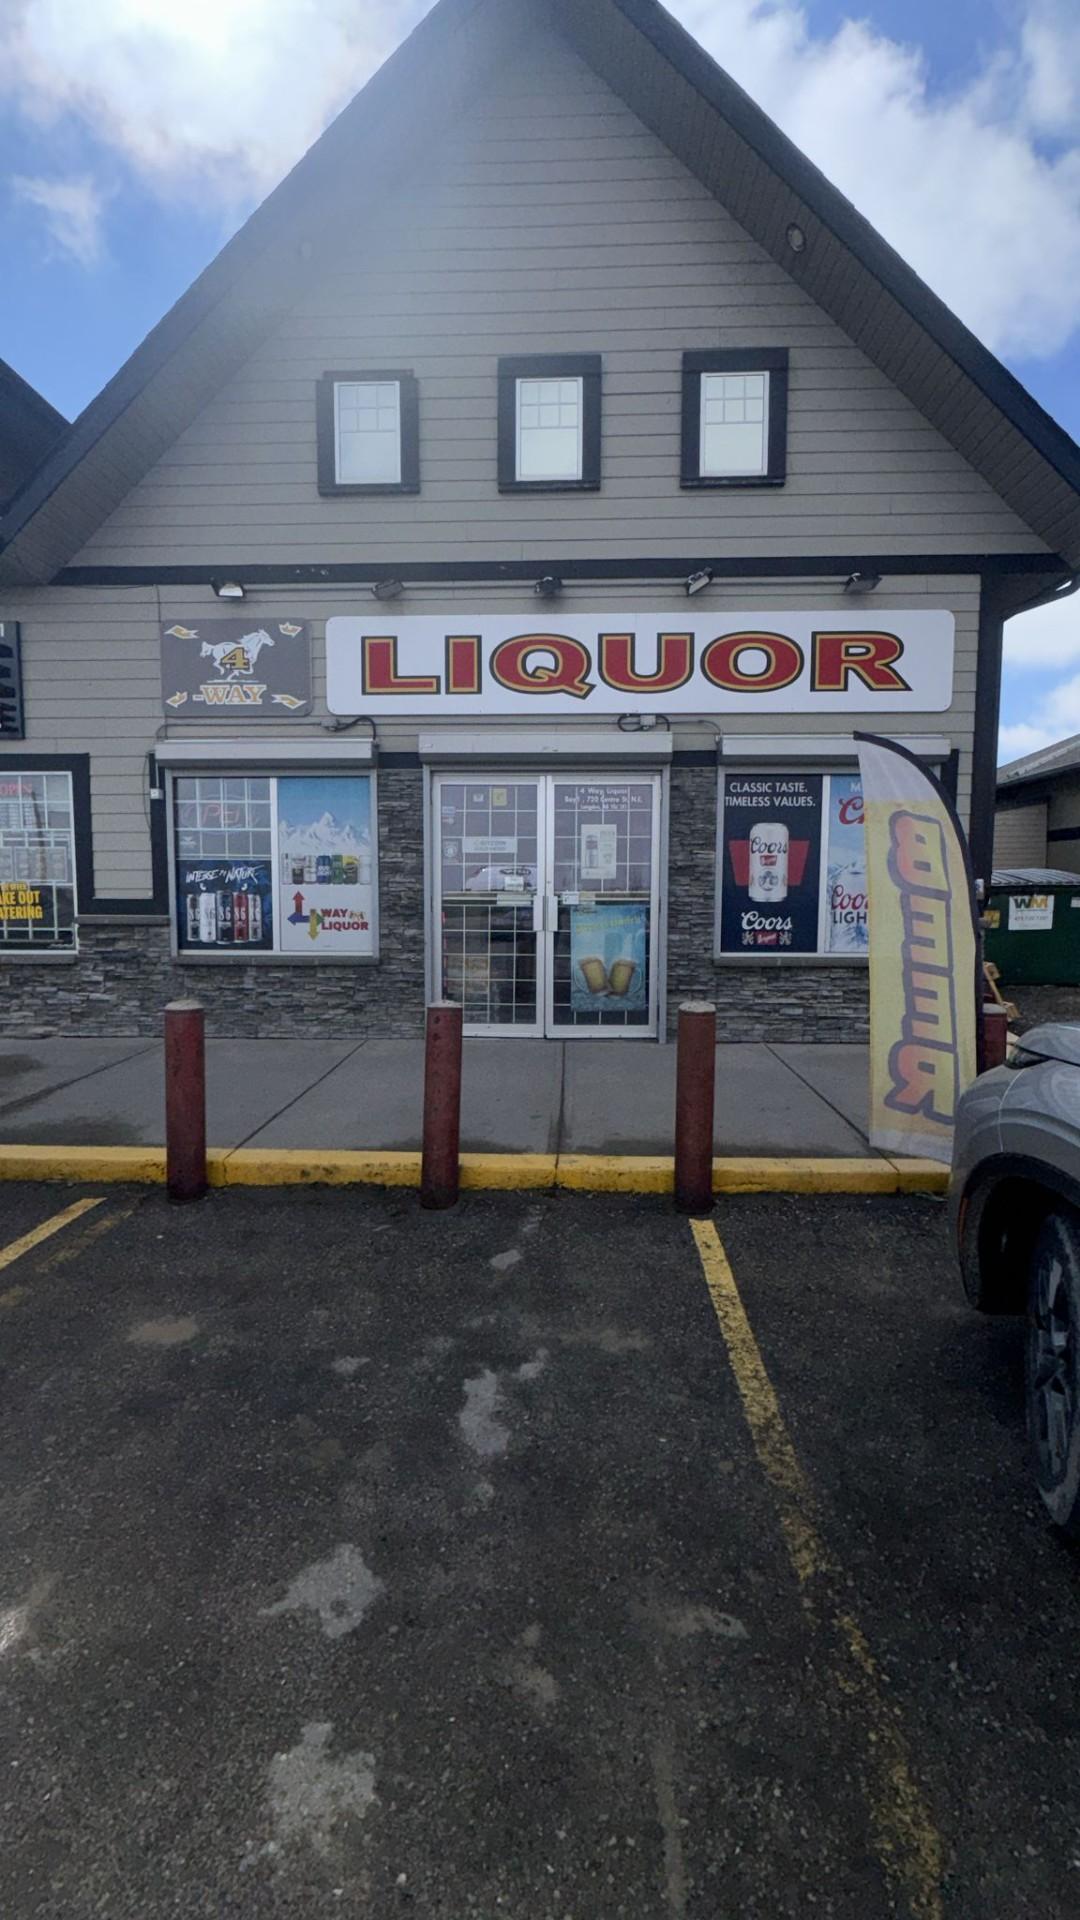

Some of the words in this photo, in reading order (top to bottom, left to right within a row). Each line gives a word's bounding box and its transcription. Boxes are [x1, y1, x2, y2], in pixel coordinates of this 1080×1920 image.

[220, 646, 250, 671] 4
[361, 631, 912, 699] LIQUOR
[587, 787, 604, 797] Way
[730, 782, 772, 793] CLASSIC
[775, 782, 808, 793] TASTE.
[725, 796, 771, 807] TIMELESS
[772, 796, 816, 807] VALUES.
[750, 836, 788, 854] Coors
[18, 891, 40, 904] OUT
[831, 884, 868, 910] Coo
[1013, 897, 1049, 909] WM
[0, 905, 43, 919] ATERING
[320, 908, 348, 918] WAY
[833, 911, 867, 924] LIGH
[321, 921, 369, 932] LIQUOR
[741, 911, 792, 930] Coors
